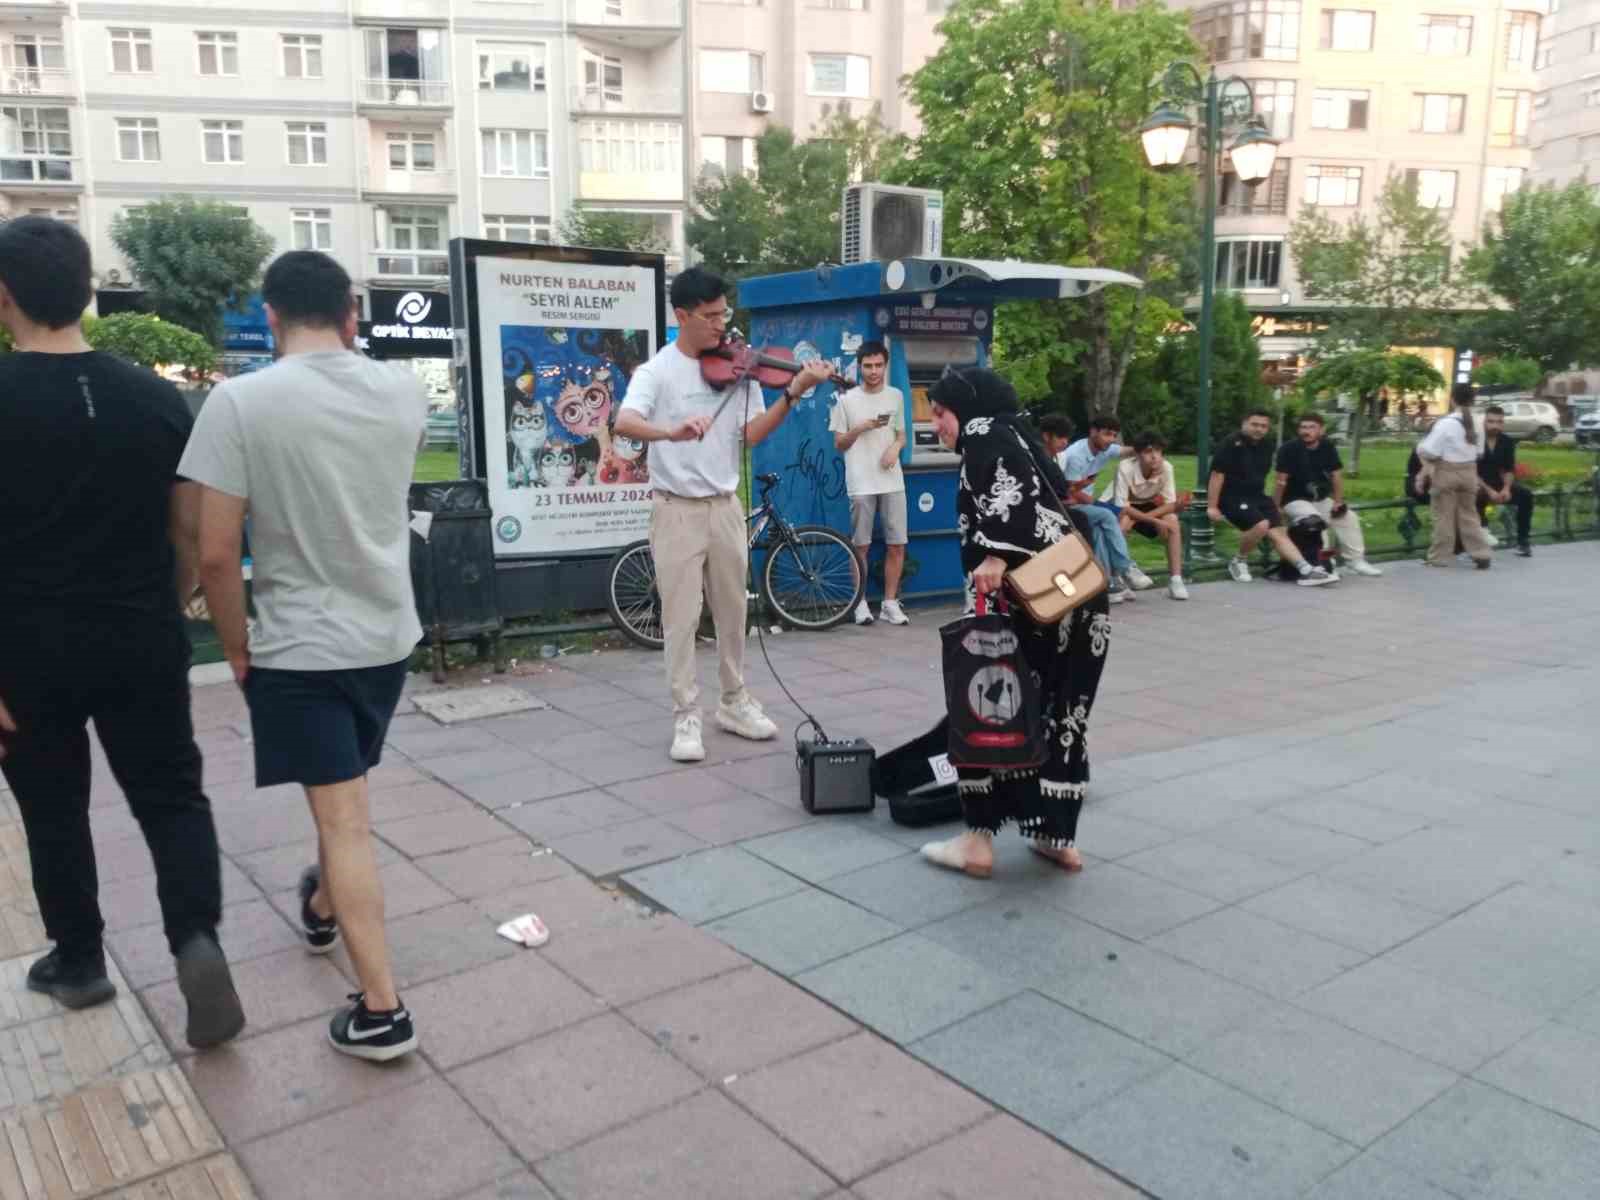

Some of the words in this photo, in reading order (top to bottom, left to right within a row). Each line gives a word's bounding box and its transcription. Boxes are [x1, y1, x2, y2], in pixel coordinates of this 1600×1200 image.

[500, 272, 563, 289] NURTEN
[568, 278, 636, 292] BALABAN
[535, 495, 552, 507] 23
[558, 491, 616, 505] TEMMUZ
[621, 489, 654, 502] 2024
